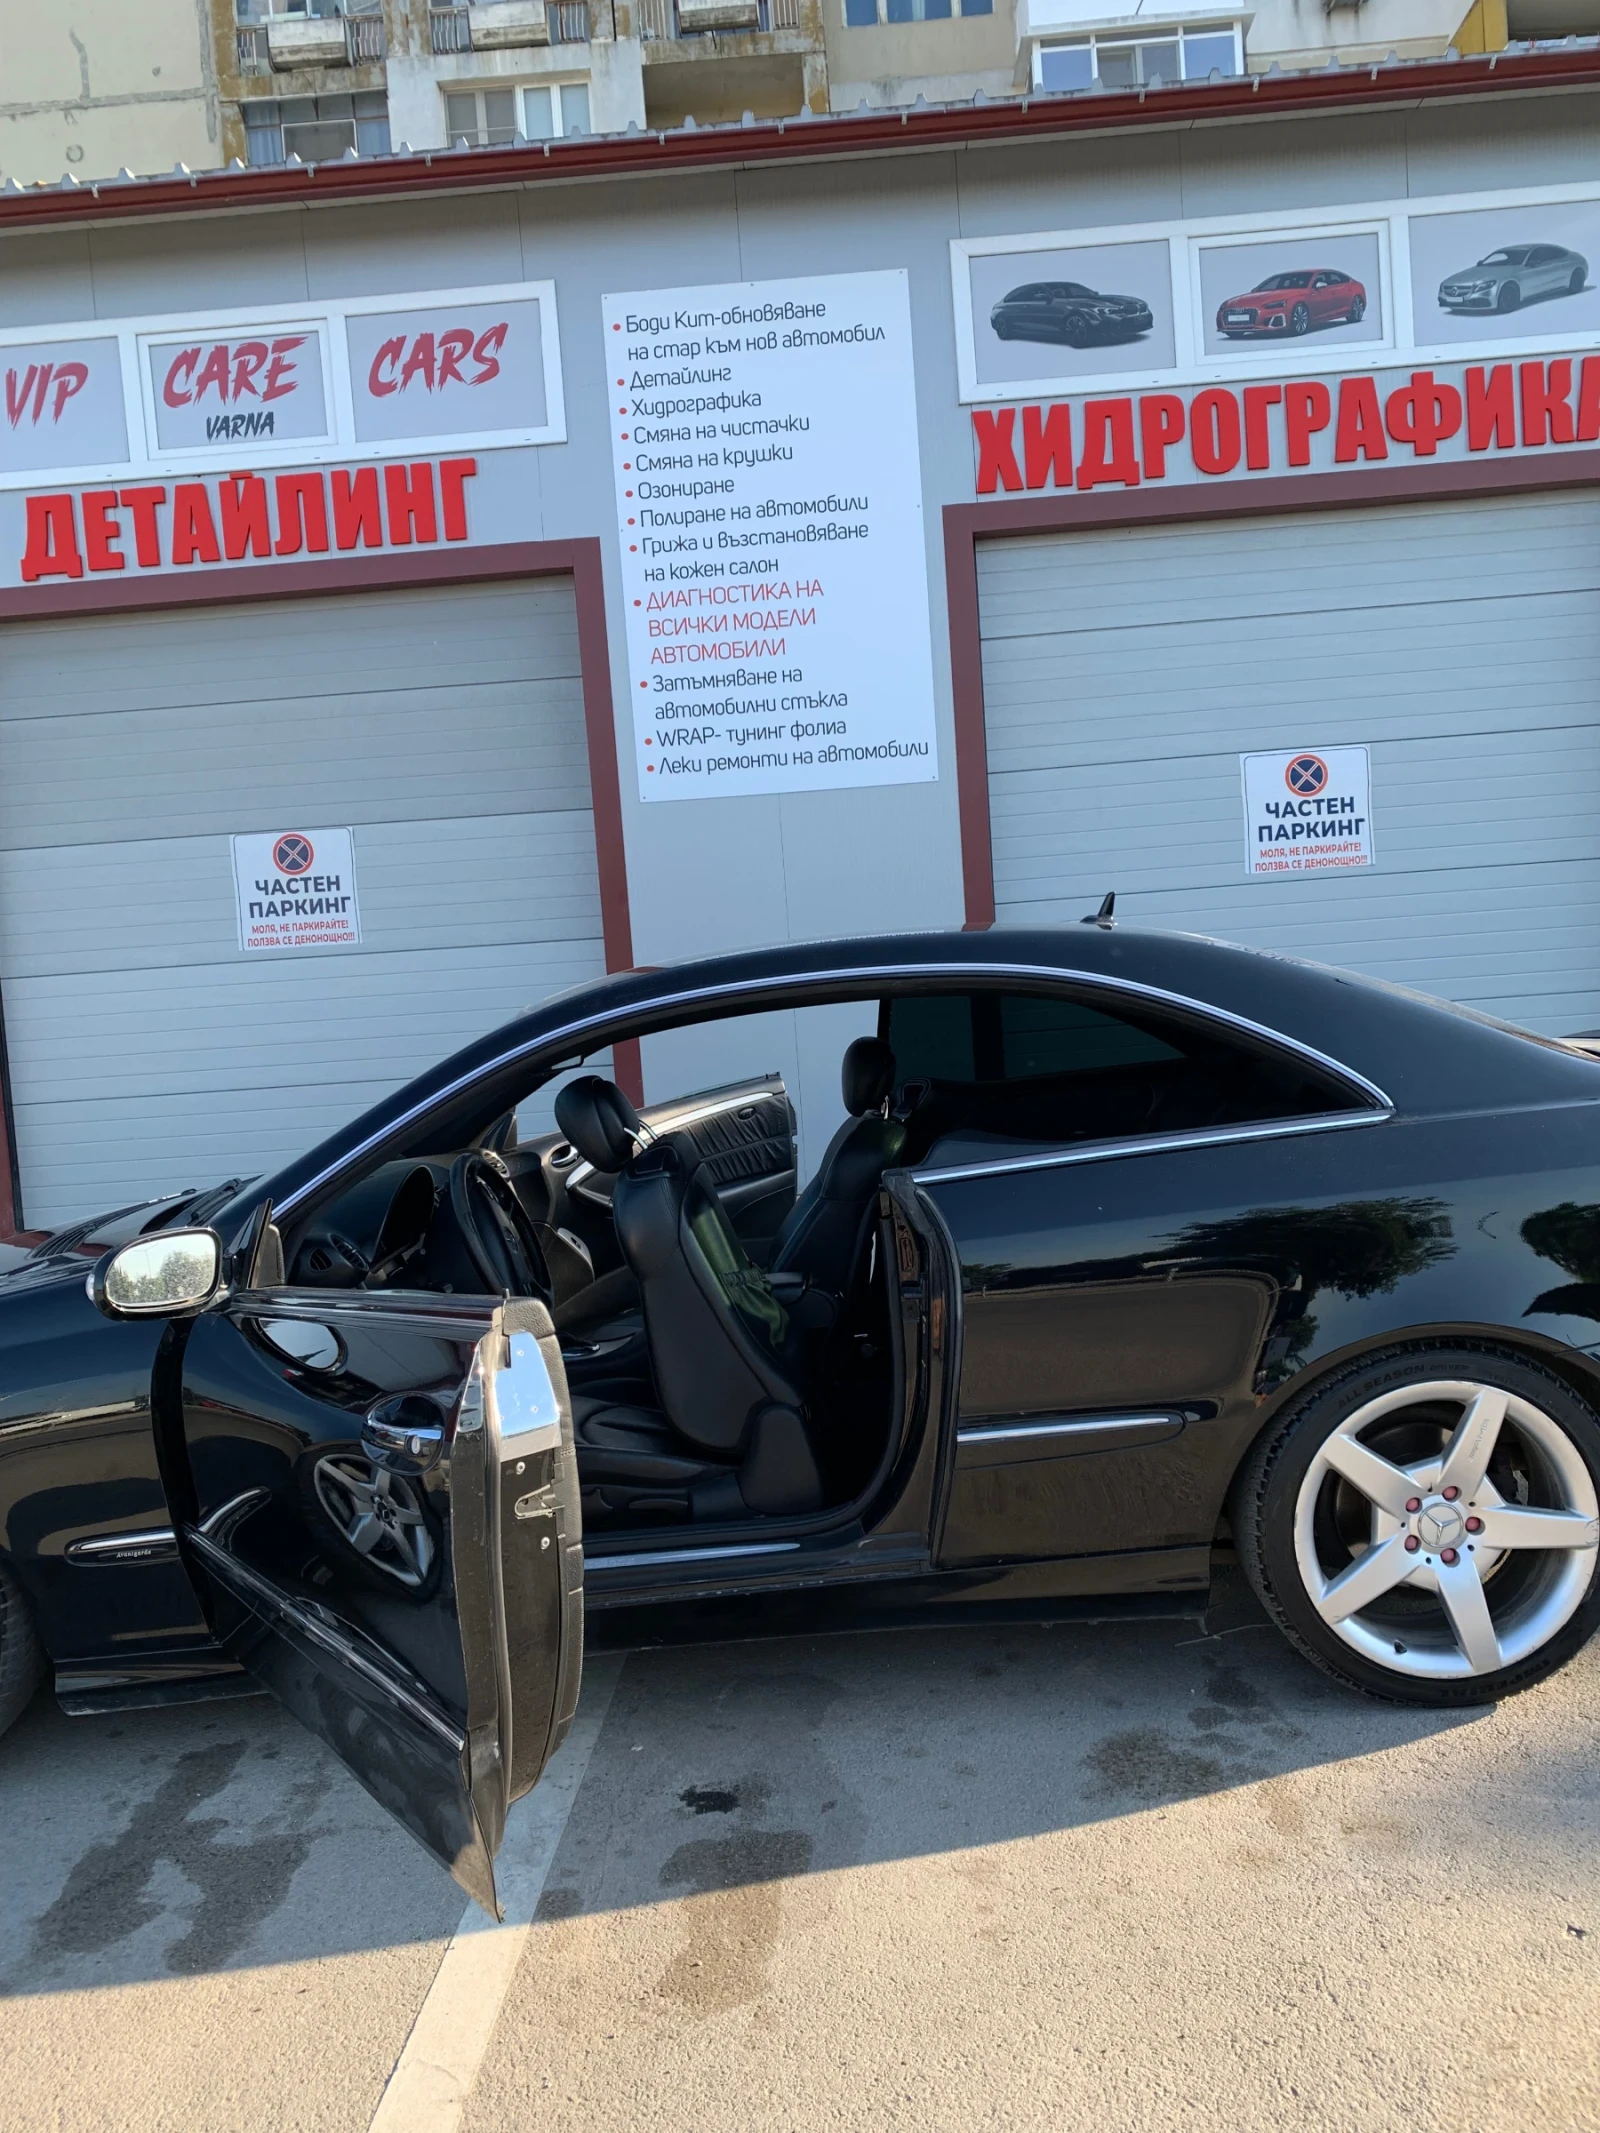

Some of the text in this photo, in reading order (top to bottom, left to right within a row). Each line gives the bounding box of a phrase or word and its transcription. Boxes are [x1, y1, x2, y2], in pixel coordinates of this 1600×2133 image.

[626, 315, 670, 335] Боди
[628, 324, 885, 360] на стар към нов автомобил
[5, 321, 509, 430] VIP CARE CARS
[630, 367, 731, 391] Детайлинг
[631, 390, 761, 419] Хидрографика
[206, 411, 275, 442] VARNA
[634, 414, 809, 444] Смяна на чистачки
[636, 444, 792, 471] Смяна на крушки
[638, 479, 734, 499] Озониране
[20, 457, 476, 582] ДЕТАЙЛИНГ
[641, 495, 868, 528] Полиране на автомобили
[643, 522, 868, 557] Грижа и възстановяване
[645, 559, 778, 582] на кожен салон
[647, 579, 824, 612] ДИАГНОСТИКА НА
[649, 608, 815, 637] ВСИЧКИ МОДЕЛИ
[651, 638, 785, 664] АВТОМОБИЛИ
[653, 669, 802, 692] Затъмняване на
[655, 691, 847, 719] автомобилни стъкла
[656, 720, 846, 747] WRAP- тунинг фолиа
[660, 740, 928, 775] Леки ремонти на автомобили
[1265, 796, 1355, 819] ЧАСТЕН
[1258, 818, 1365, 842] ПАРКИНГ
[1260, 841, 1361, 859] МОЛЯ, НЕ ПАРКИРАЙТЕ!
[1255, 861, 1290, 872] ПОЛЗВА
[1292, 859, 1302, 869] СЕ
[255, 875, 341, 896] ЧАСТЕН
[249, 896, 351, 919] ПАРКИНГ
[252, 919, 349, 935] МОЛЯ, НЕ ПАРКИРАЙТЕ!
[247, 937, 281, 948] ПОЛЗВА
[282, 936, 292, 945] СЕ
